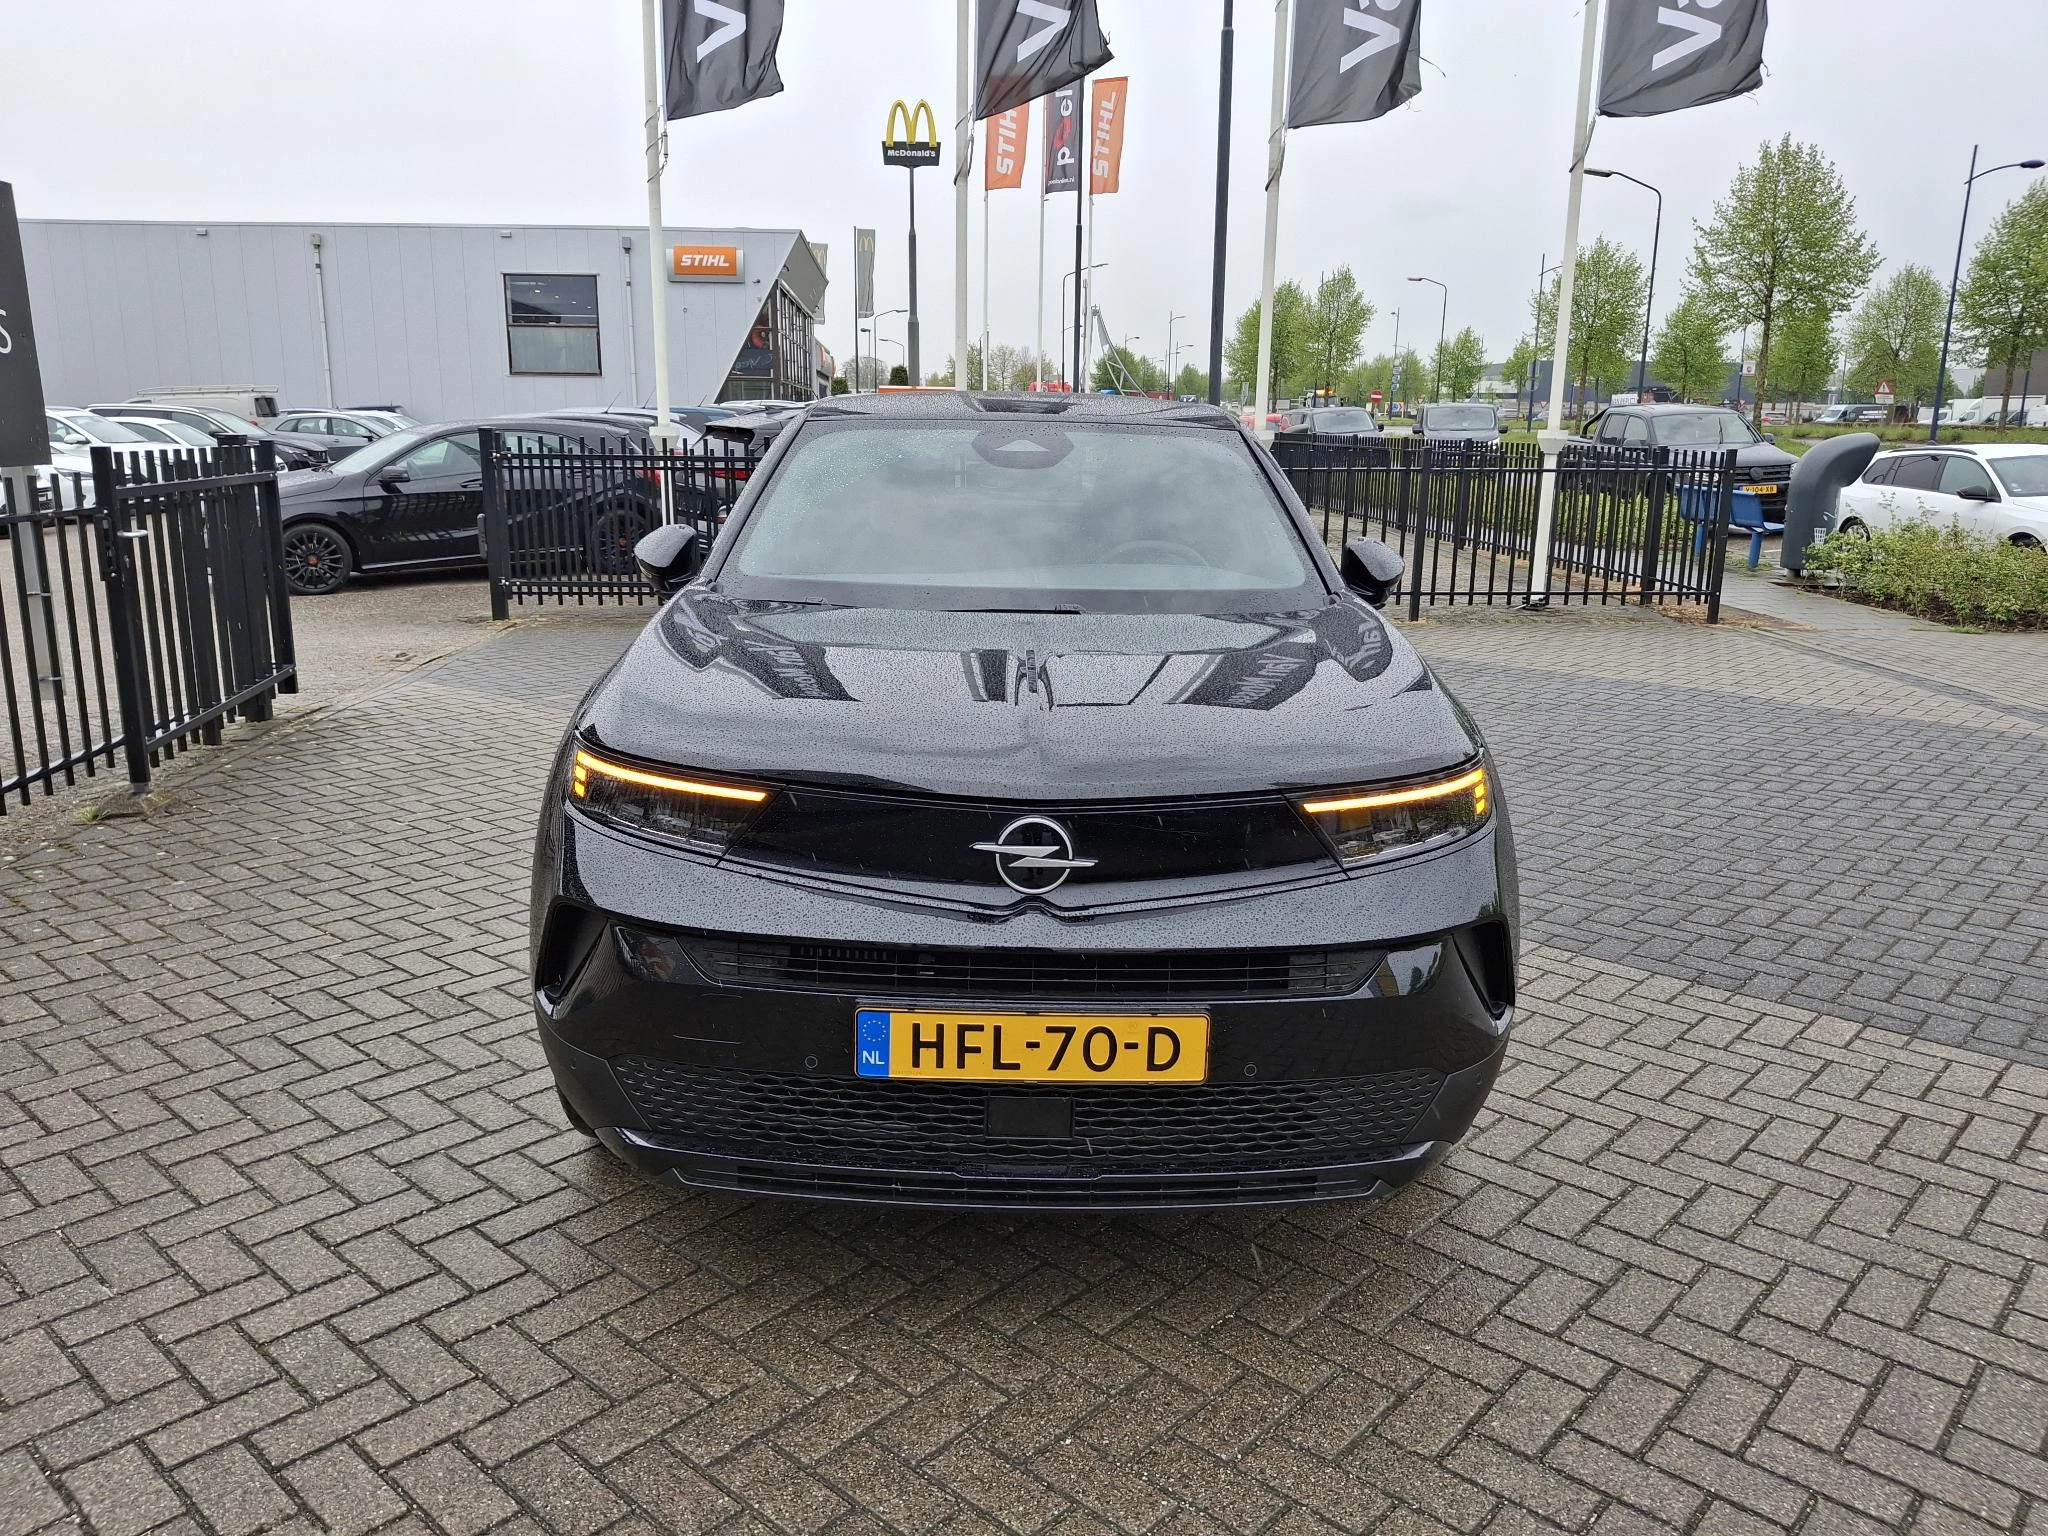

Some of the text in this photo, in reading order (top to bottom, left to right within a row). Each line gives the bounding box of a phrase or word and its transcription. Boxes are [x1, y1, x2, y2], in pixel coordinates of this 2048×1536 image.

[1340, 0, 1401, 74] V
[1652, 0, 1723, 71] V
[887, 149, 936, 157] McDonald's
[1092, 91, 1117, 178] STIHL
[680, 254, 730, 267] STIHL
[863, 1050, 885, 1065] NL
[911, 1022, 1181, 1072] HFL-70-D
